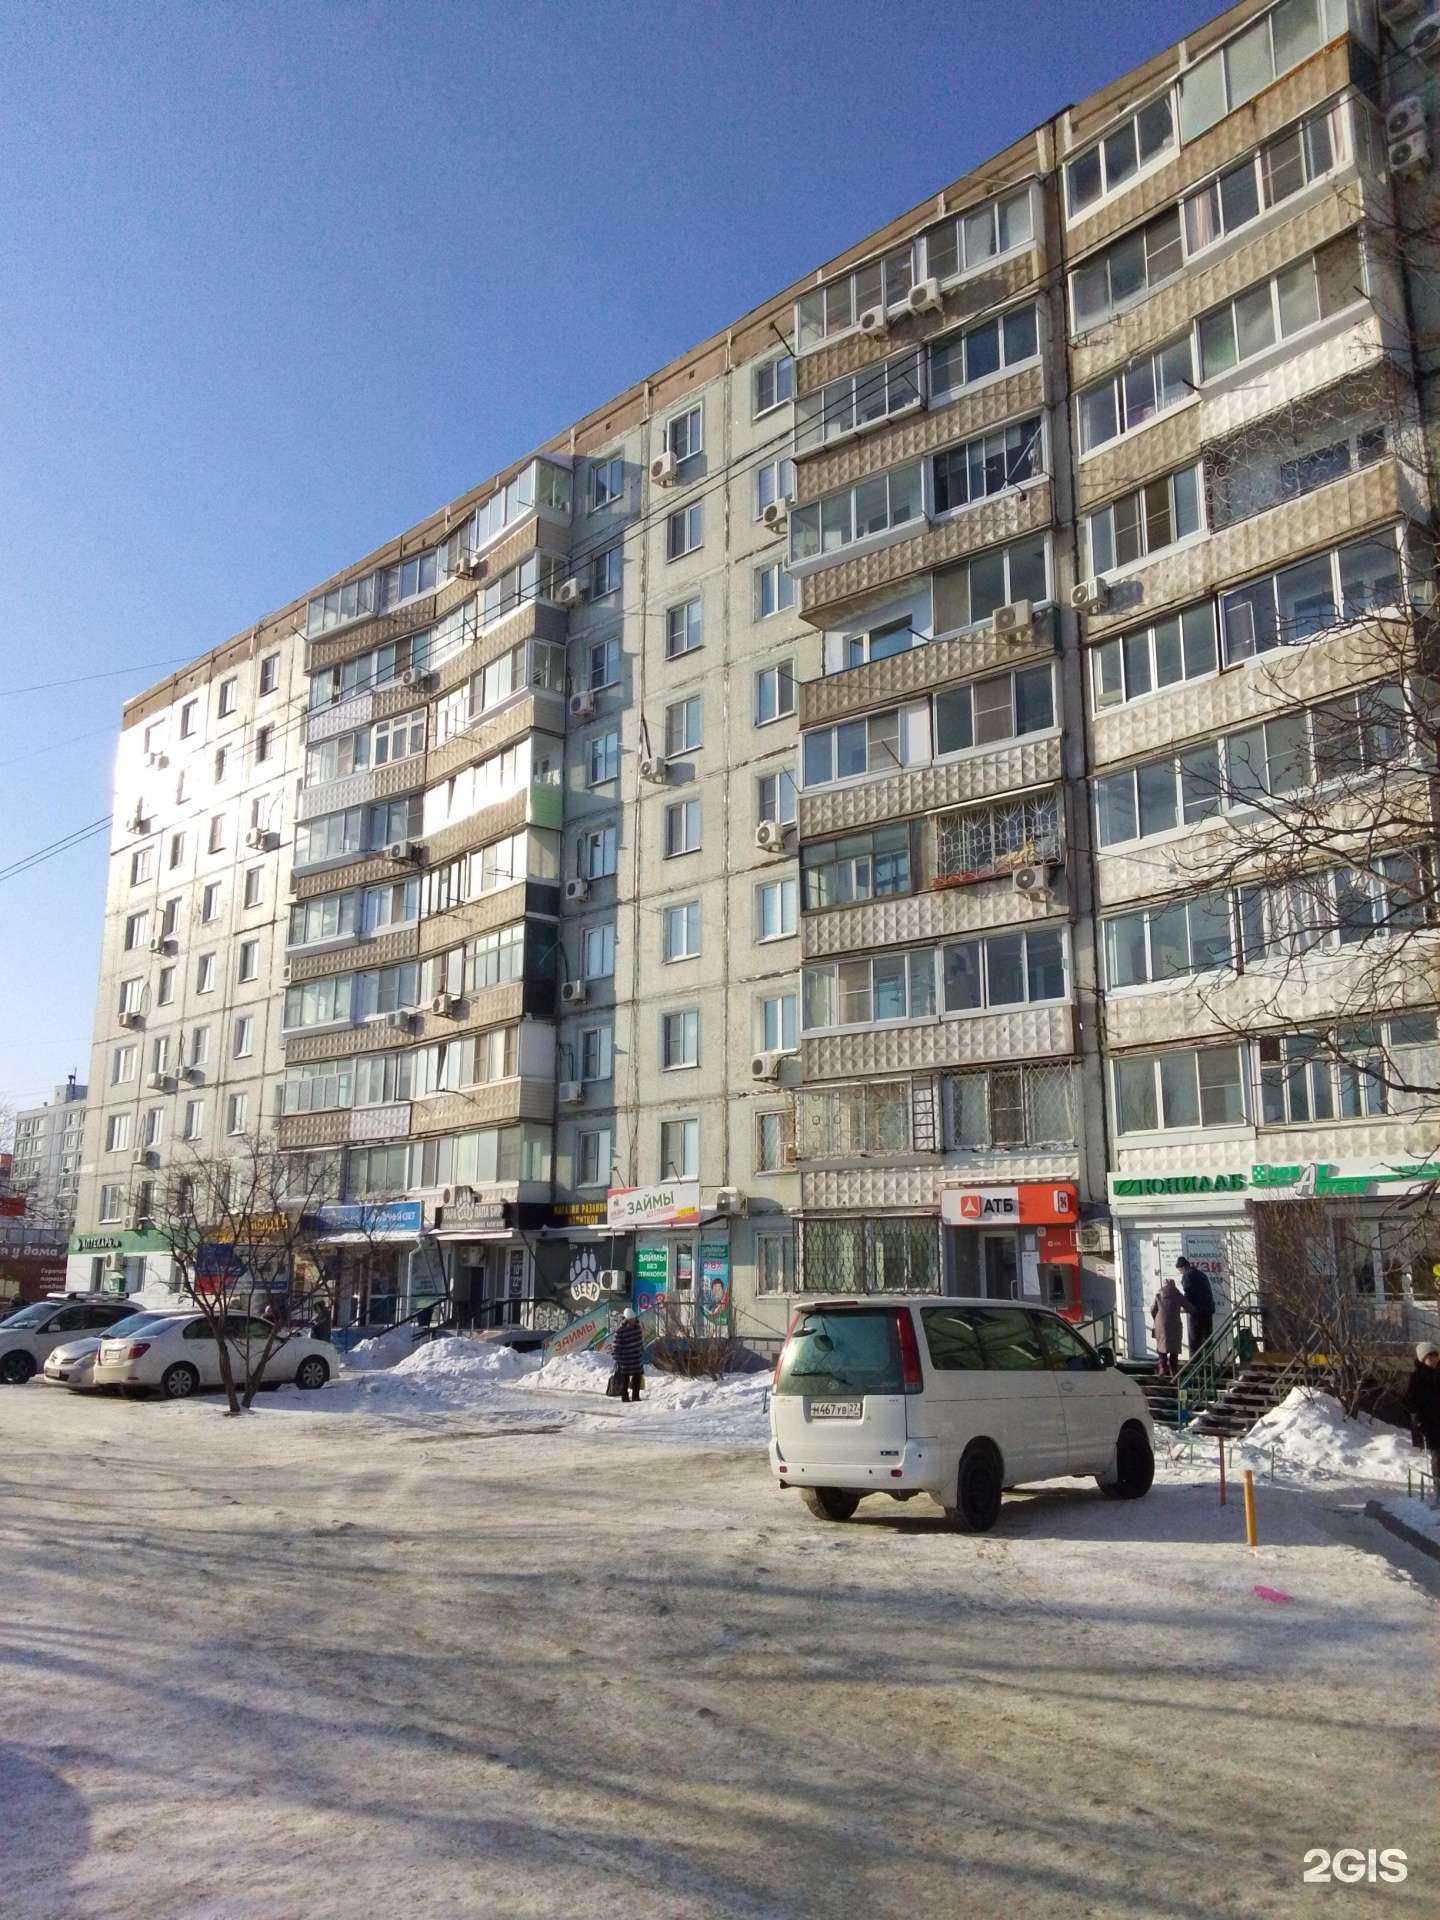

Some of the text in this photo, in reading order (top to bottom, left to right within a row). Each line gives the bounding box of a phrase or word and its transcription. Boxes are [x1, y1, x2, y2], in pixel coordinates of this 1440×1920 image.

[627, 1191, 674, 1215] ЗАЙМЫ
[984, 1198, 1014, 1213] АТБ
[11, 1248, 20, 1259] у
[24, 1245, 58, 1256] дома
[639, 1252, 667, 1262] ЗАЙМЫ
[574, 1281, 598, 1299] BEER
